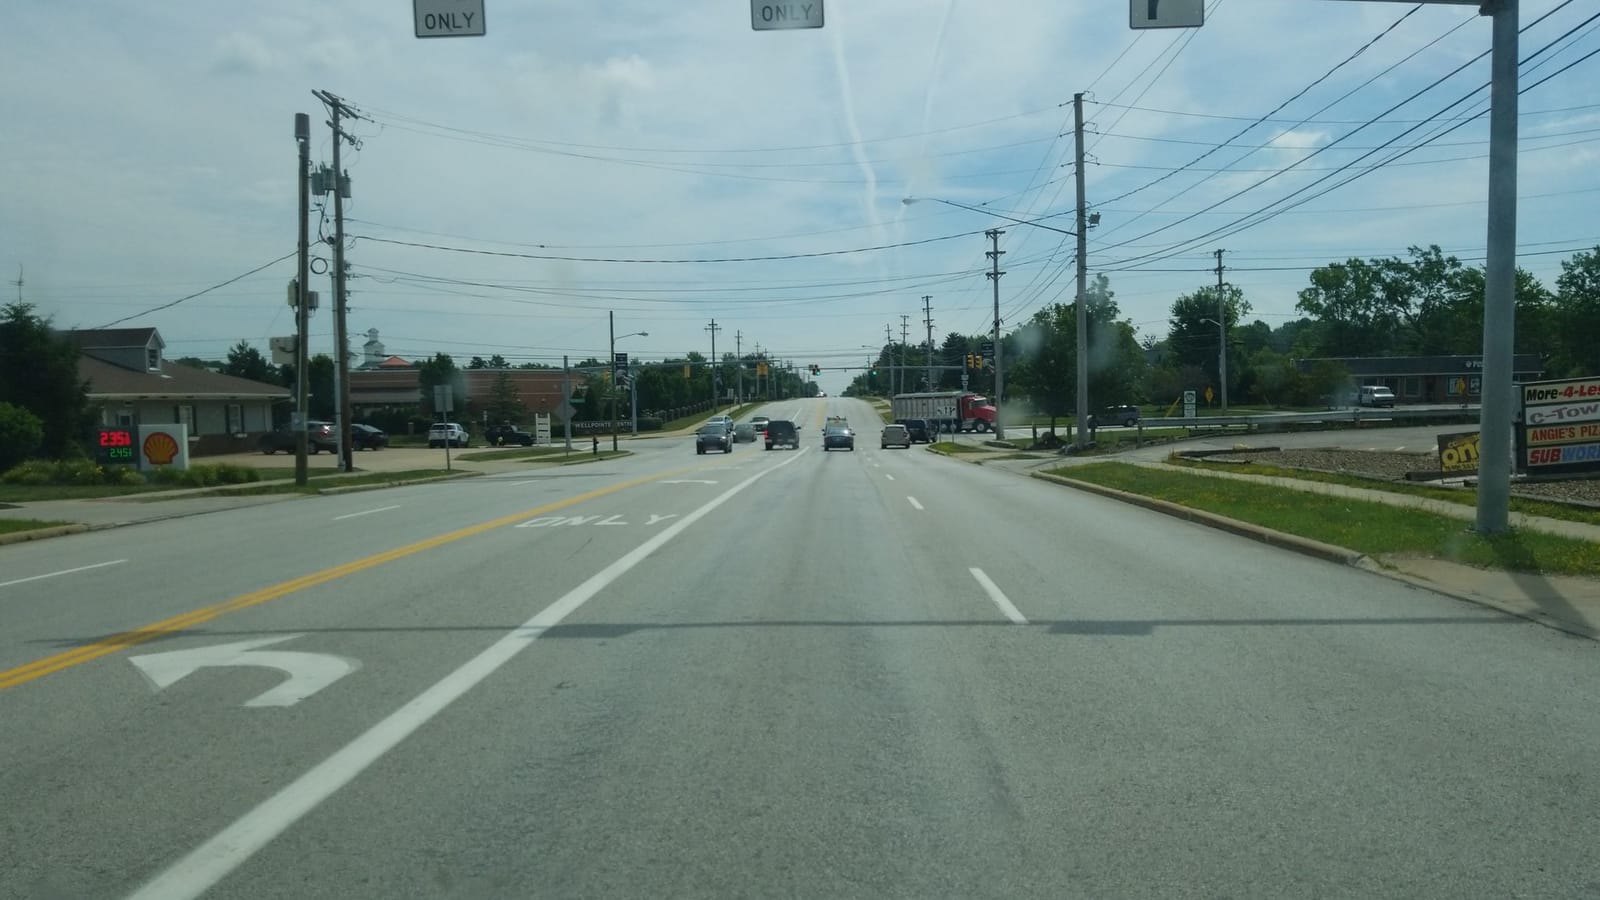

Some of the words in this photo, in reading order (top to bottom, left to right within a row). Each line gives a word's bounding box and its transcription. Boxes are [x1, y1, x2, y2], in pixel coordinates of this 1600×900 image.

[425, 12, 474, 30] ONLY
[761, 4, 813, 22] ONLY
[1526, 384, 1600, 401] More-4-Le
[1531, 426, 1576, 441] ANGIE'S
[1580, 424, 1600, 437] PIZ
[514, 513, 679, 528] ONLY
